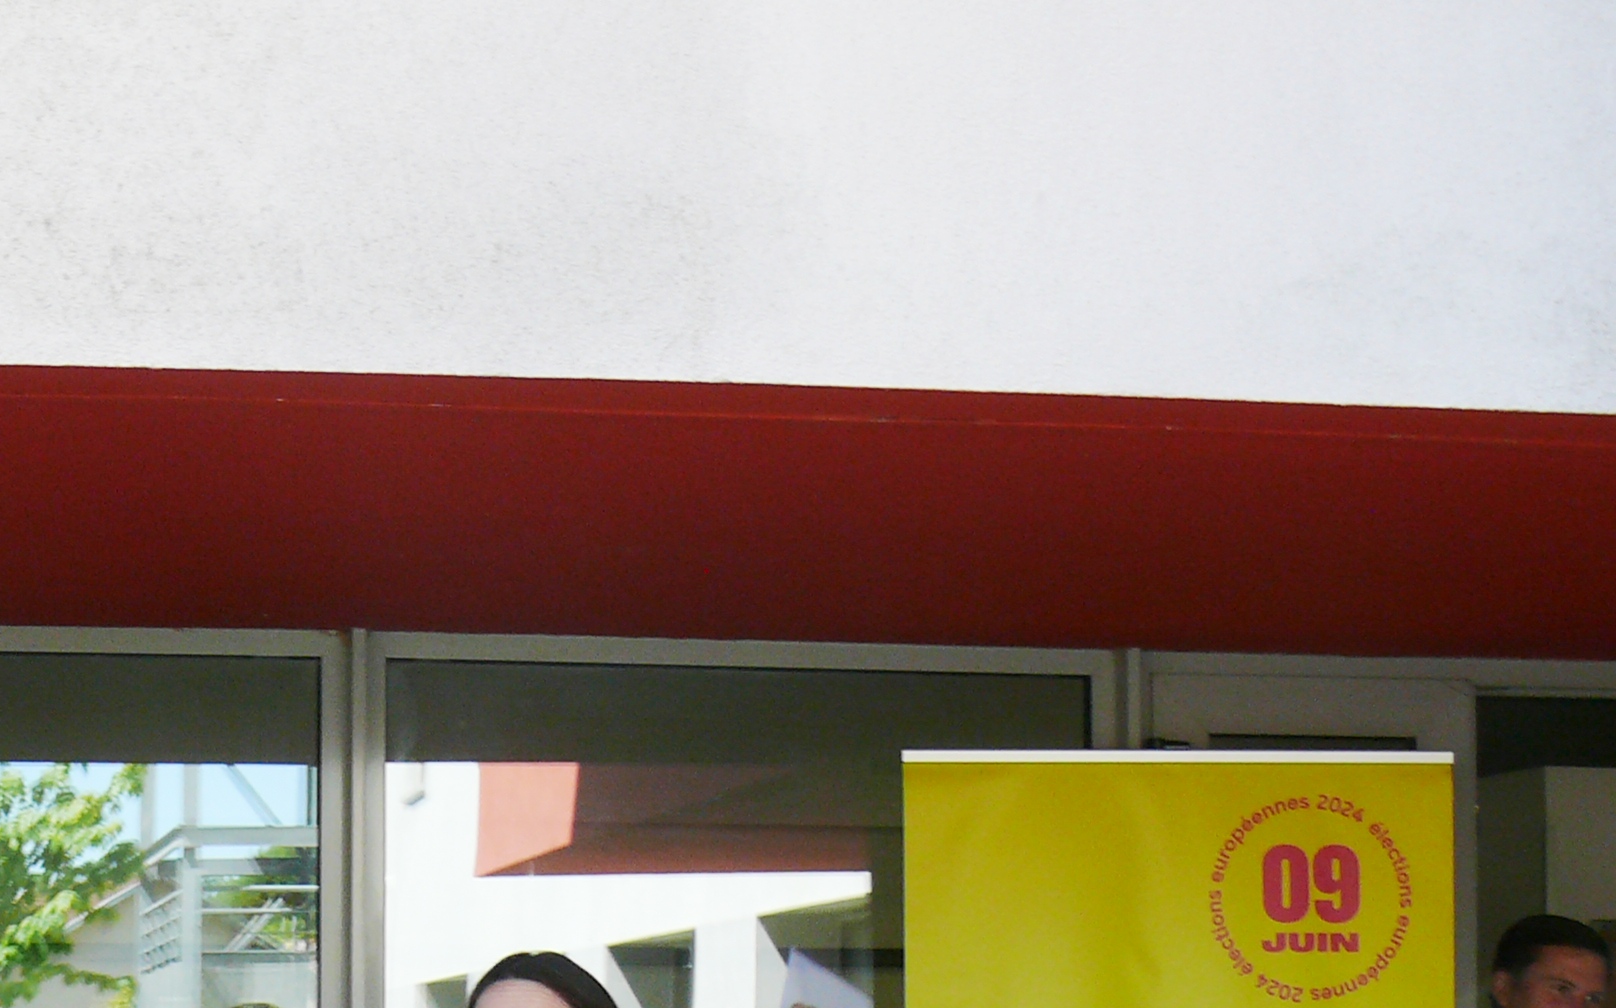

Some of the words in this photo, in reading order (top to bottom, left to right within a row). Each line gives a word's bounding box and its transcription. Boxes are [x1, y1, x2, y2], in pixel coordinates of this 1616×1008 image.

[1211, 796, 1310, 883] européennes
[1316, 794, 1365, 822] 2024
[1262, 843, 1361, 924] 09
[1368, 821, 1412, 909] élections
[1209, 889, 1253, 976] élections
[1261, 932, 1360, 953] JUIN
[1310, 914, 1410, 1001] européennes
[1256, 973, 1304, 1003] 2024
